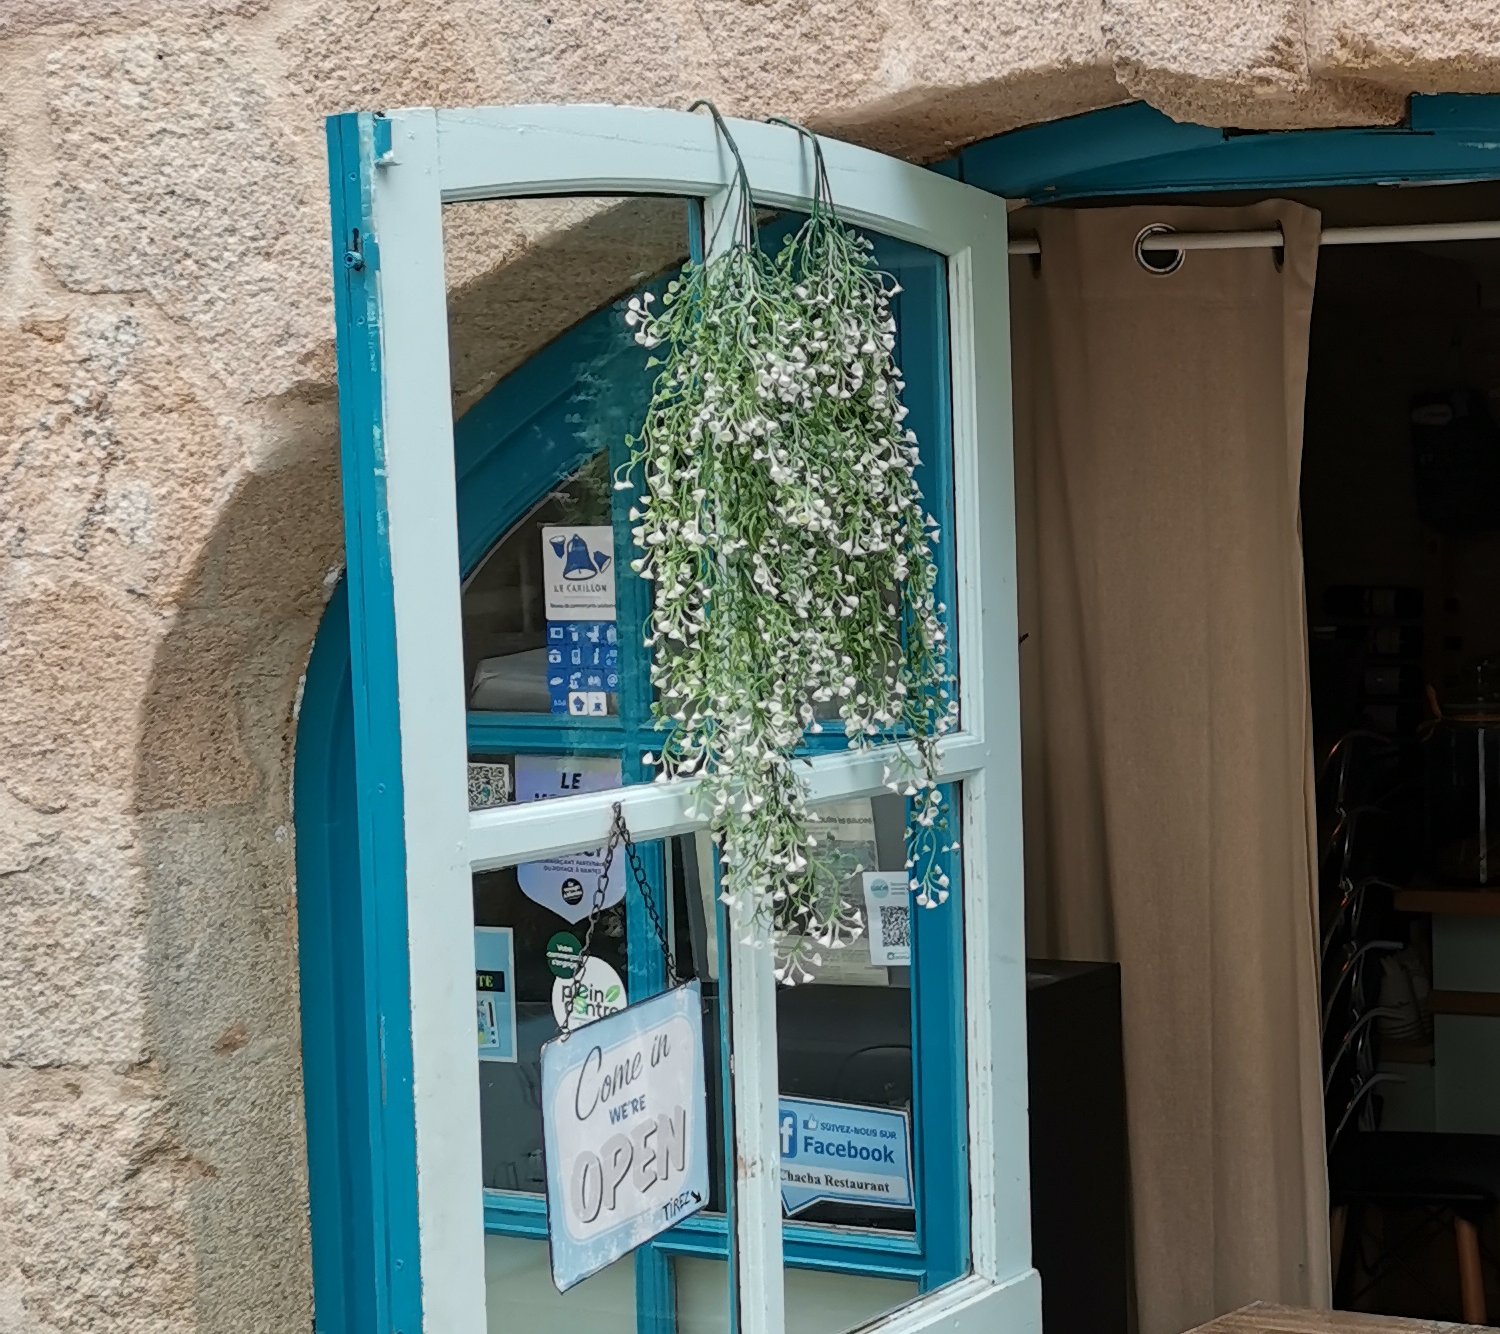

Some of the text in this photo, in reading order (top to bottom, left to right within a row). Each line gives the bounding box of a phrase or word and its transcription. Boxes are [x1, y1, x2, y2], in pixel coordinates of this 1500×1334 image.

[566, 584, 607, 592] CARILLON
[561, 773, 582, 789] LE
[576, 1031, 670, 1121] Come in
[609, 1095, 646, 1125] WE'RE
[880, 1130, 897, 1140] SUR
[804, 1136, 895, 1164] Facebook
[570, 1105, 686, 1223] OPEN
[824, 1174, 890, 1193] Restaurant
